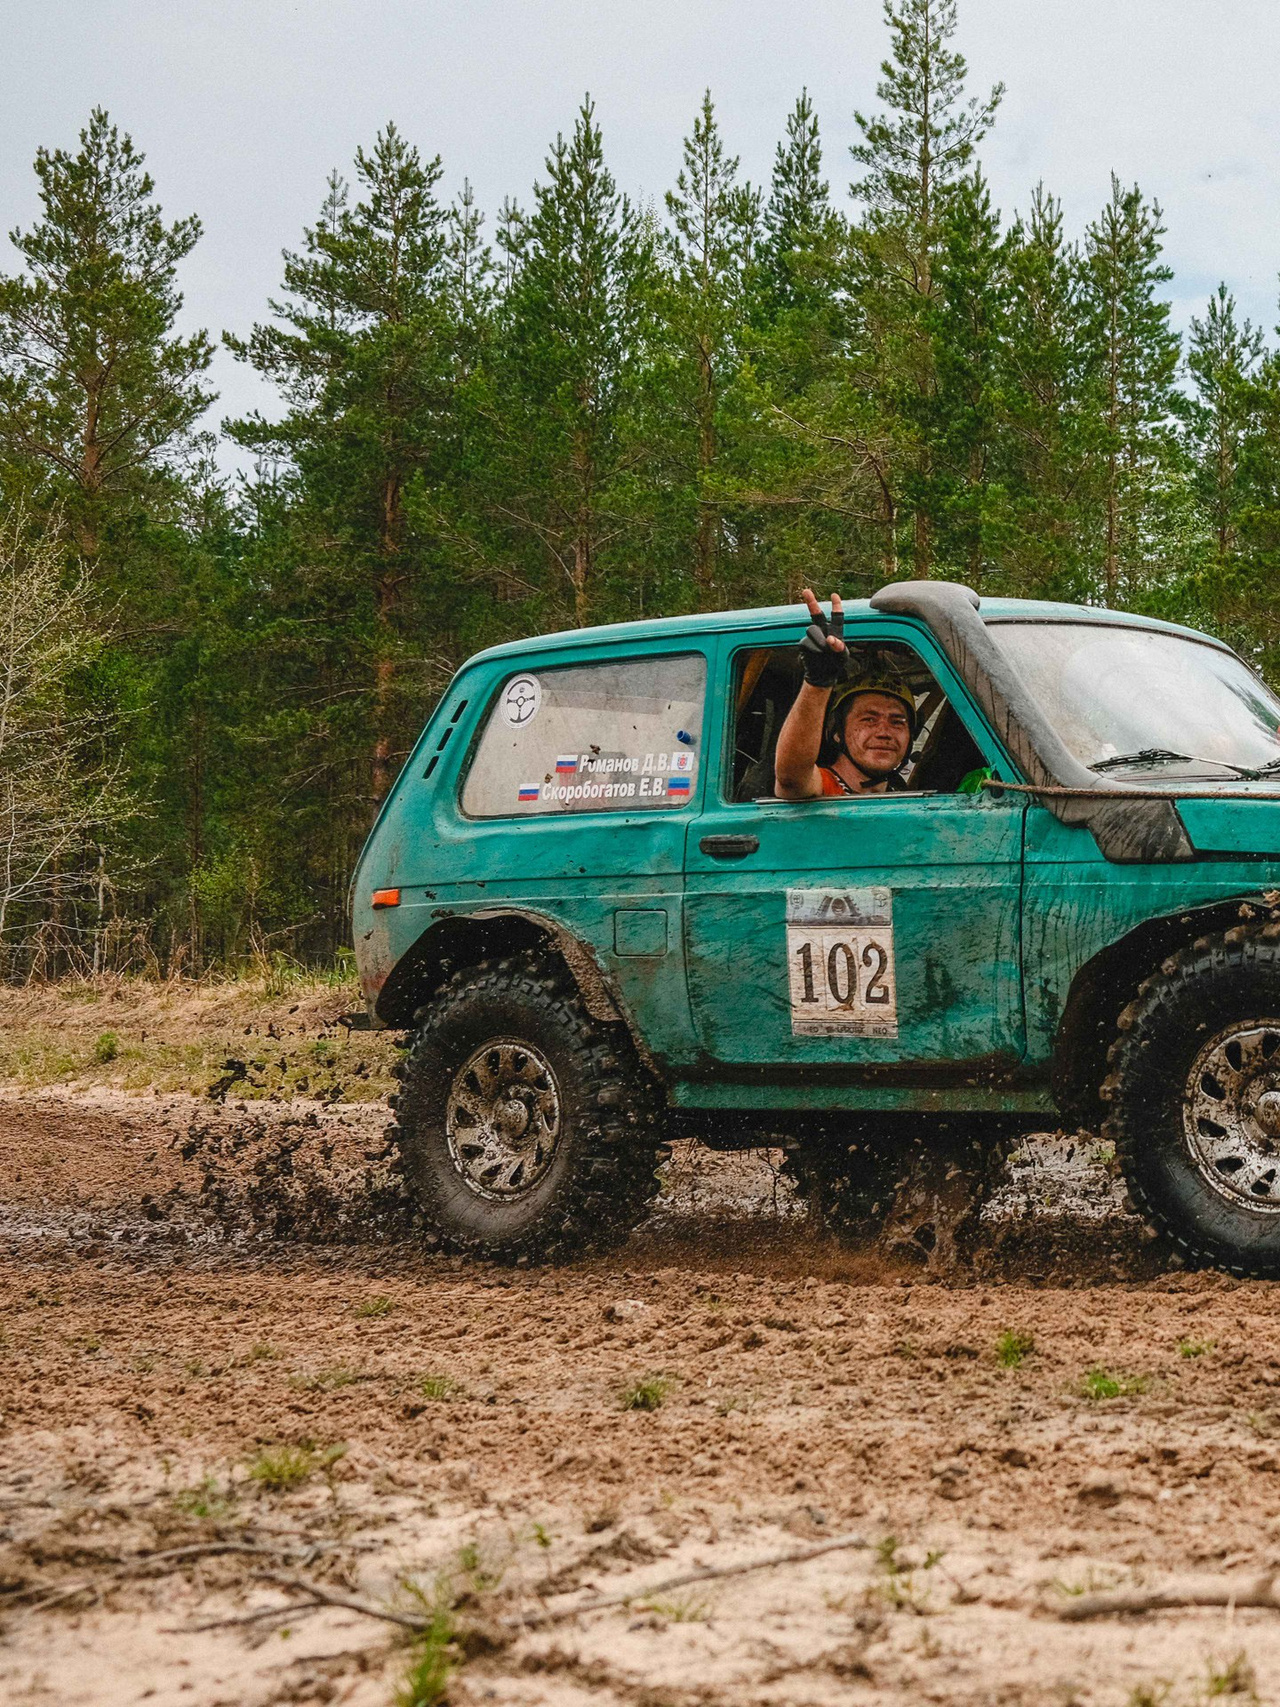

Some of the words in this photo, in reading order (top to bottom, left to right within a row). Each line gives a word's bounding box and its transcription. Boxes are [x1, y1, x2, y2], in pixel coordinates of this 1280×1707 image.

[579, 754, 639, 773] Романов
[642, 753, 671, 775] Д.В.
[542, 780, 635, 804] Скоробогатов
[639, 777, 667, 797] Е.В.
[796, 942, 890, 1004] 102
